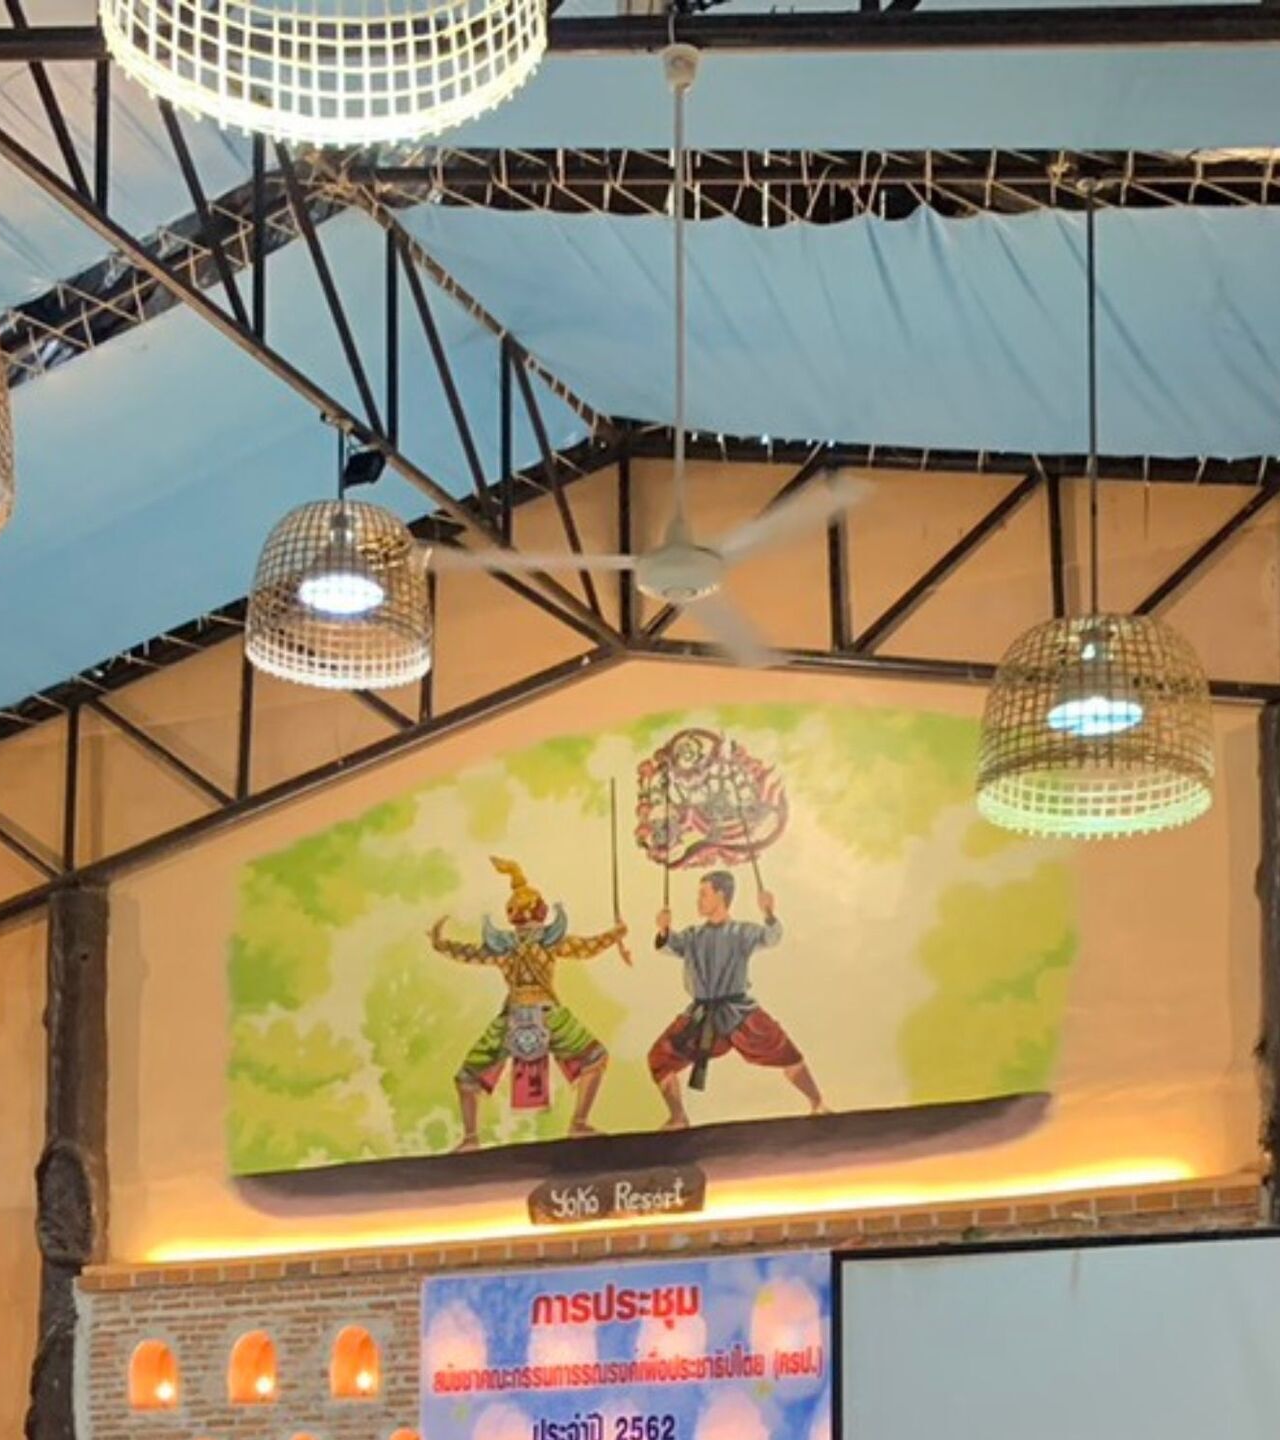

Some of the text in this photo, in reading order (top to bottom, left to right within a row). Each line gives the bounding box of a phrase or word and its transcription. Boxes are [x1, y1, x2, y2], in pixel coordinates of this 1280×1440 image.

[615, 1178, 685, 1211] Resort
[532, 1284, 699, 1328] การประชุม
